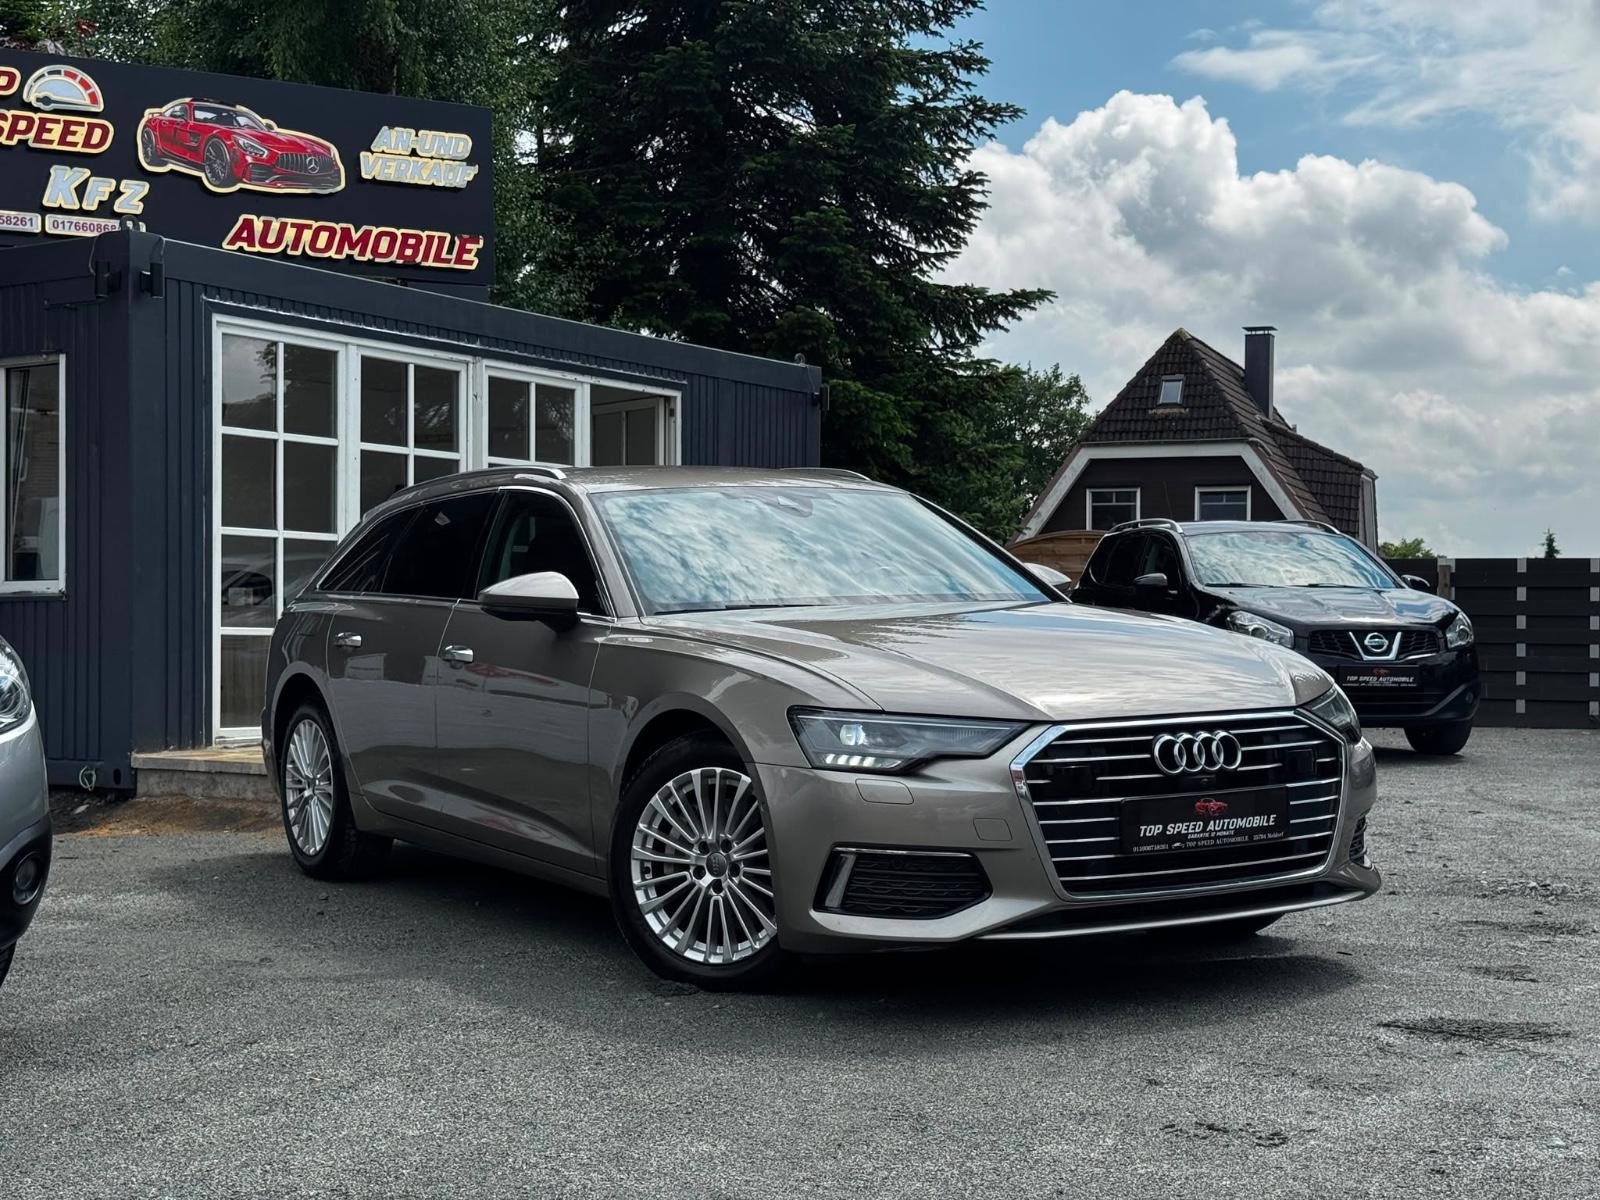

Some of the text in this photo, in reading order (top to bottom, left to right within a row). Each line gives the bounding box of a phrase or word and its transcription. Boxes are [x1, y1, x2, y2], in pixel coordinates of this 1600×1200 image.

[361, 153, 475, 187] VERKAUF
[225, 216, 482, 267] AUTOMOBILE
[1139, 814, 1277, 838] TOP SPEED AUTOMOBILE
